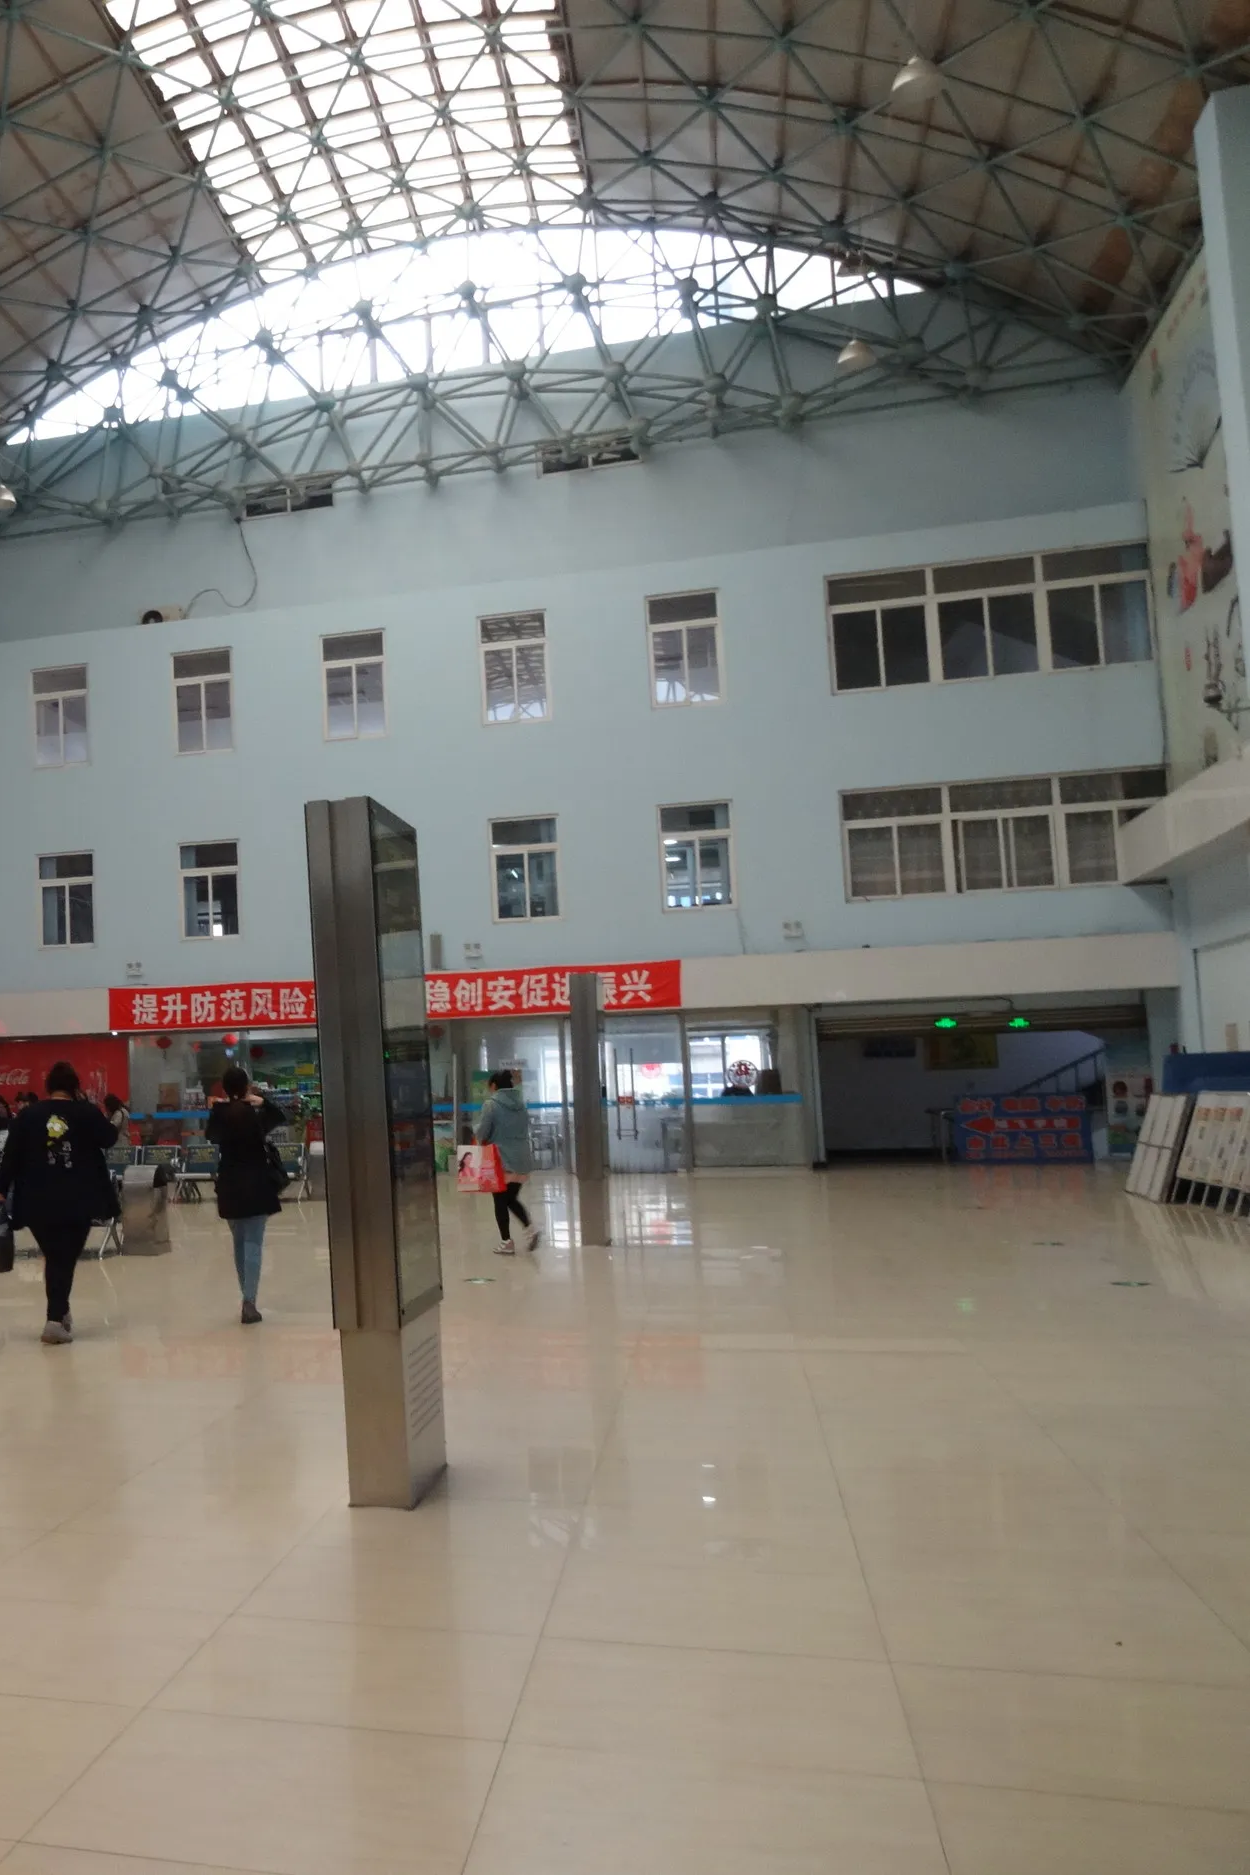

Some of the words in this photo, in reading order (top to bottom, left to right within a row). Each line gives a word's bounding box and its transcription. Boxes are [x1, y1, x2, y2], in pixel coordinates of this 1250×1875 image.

[132, 988, 317, 1025] 提升防范风险
